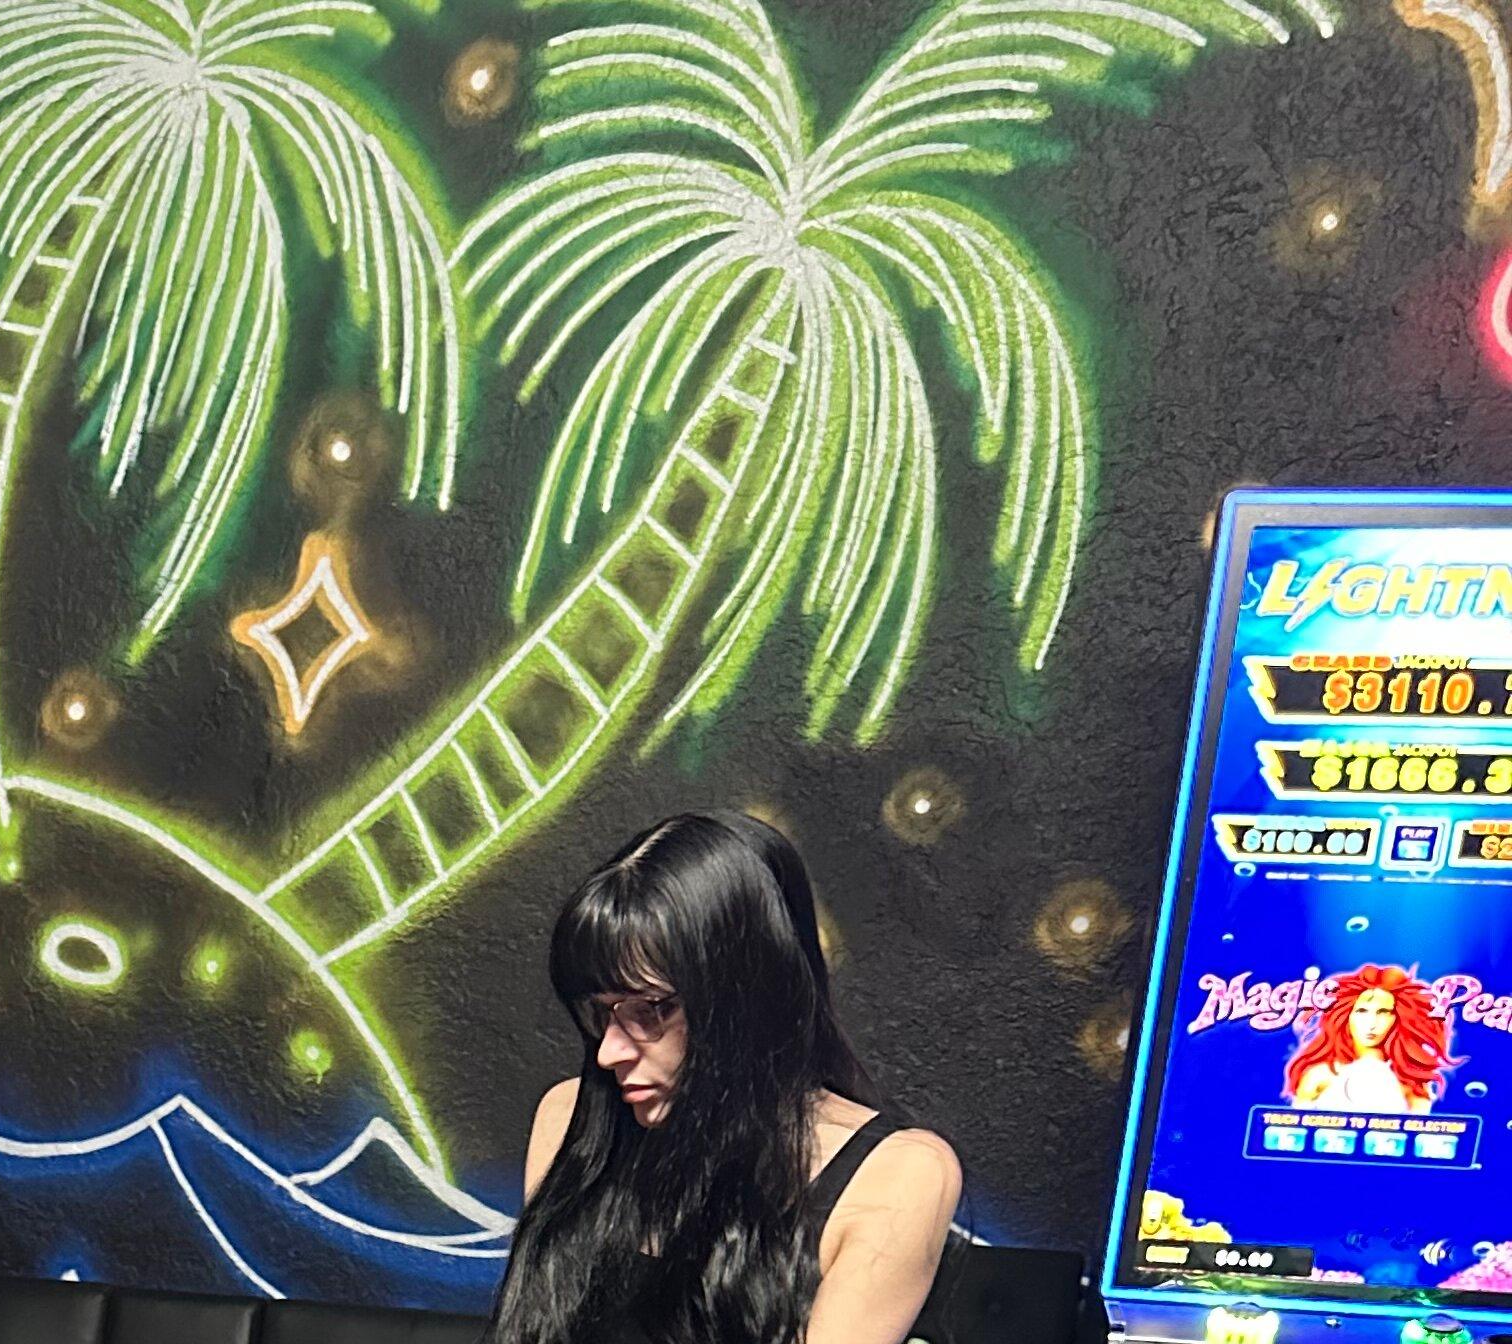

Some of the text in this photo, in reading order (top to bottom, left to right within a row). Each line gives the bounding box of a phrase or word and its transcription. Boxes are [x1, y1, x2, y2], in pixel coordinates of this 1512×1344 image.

[1187, 966, 1512, 1035] Magic Pea
[1349, 1117, 1366, 1129] TO
